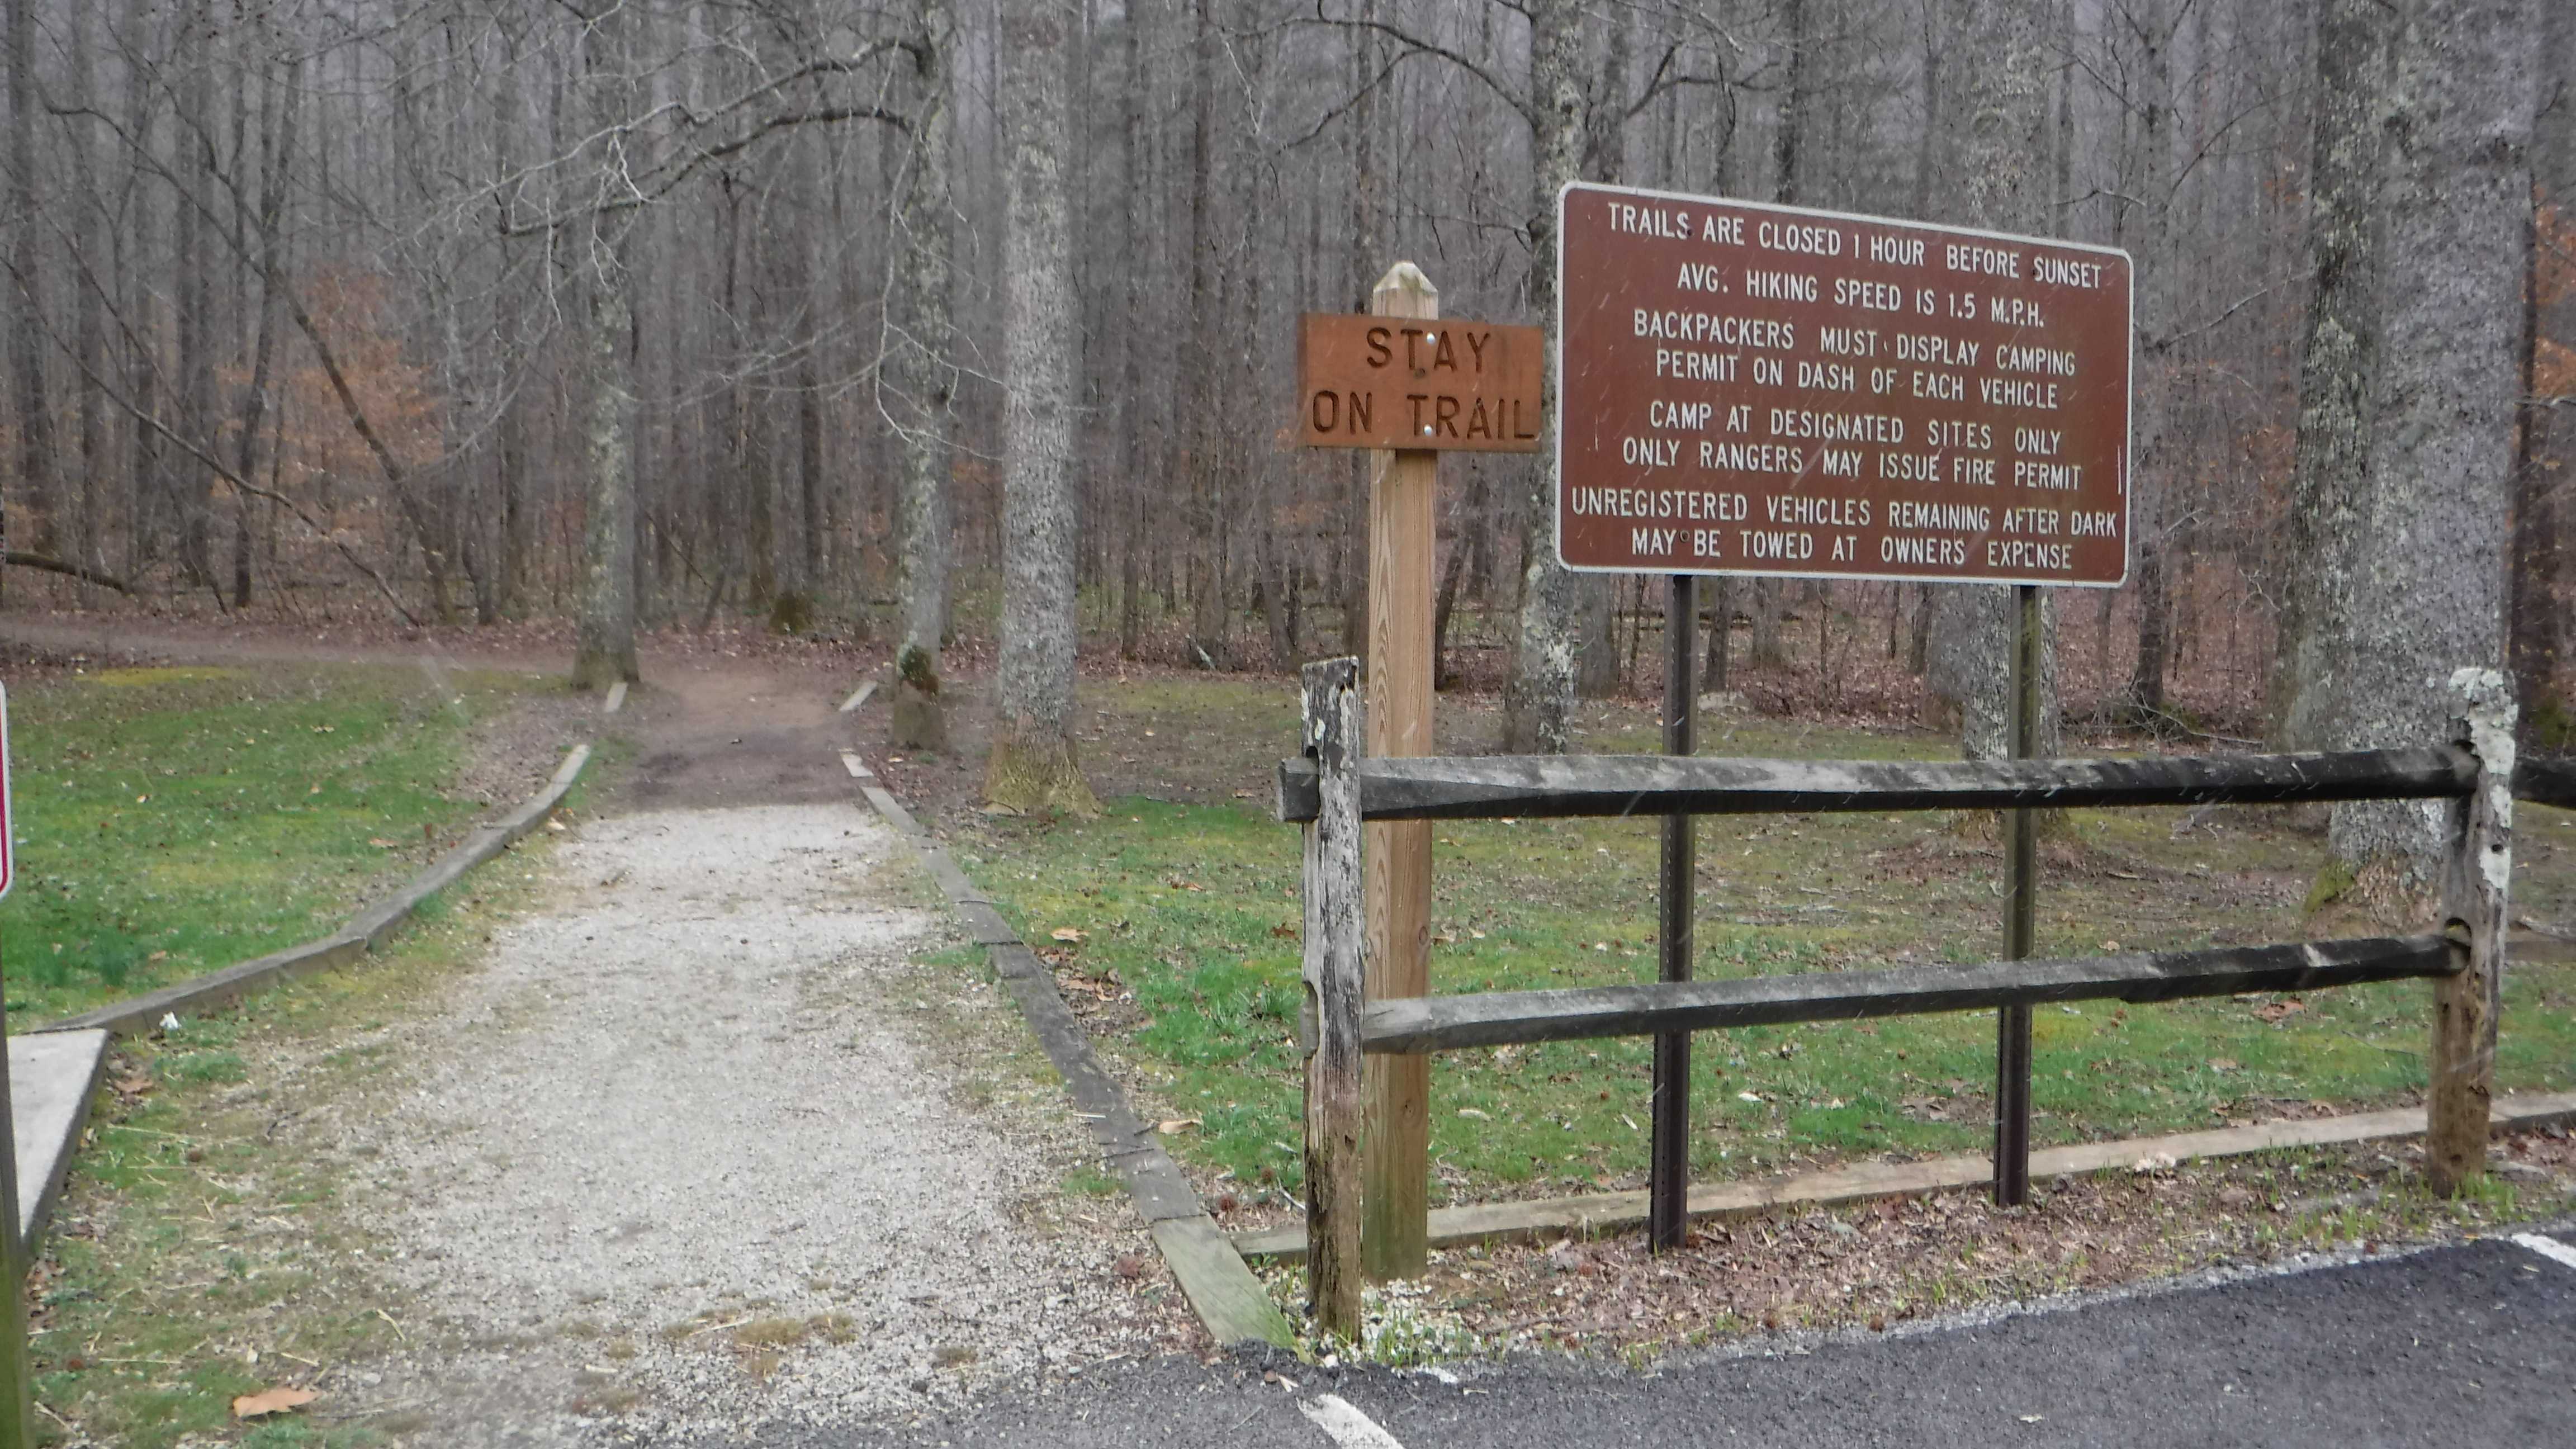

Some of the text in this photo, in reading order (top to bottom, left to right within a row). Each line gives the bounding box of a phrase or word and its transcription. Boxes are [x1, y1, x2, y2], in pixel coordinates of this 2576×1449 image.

[1608, 202, 2101, 288] TRAILS ARE CLOSED 1 HOUR BEFORE SUNSET
[1678, 262, 2044, 328] AVG. HIKING SPEED IS 1.5 M.P.H.
[1366, 327, 1490, 372] STAY
[1633, 308, 2076, 376] BACKPACKERS MUST DISPLAY CAMPING
[1656, 349, 2058, 409] PERMIT ON DASH OF EACH VEHICLE
[1313, 390, 1535, 439] ON TRAIL
[1650, 401, 2061, 455] CAMP AT DESIGNATED SITES ONLY
[1623, 437, 2082, 490] ONLY RANGERS MAY ISSUE FIRE PERMIT
[1571, 486, 2117, 537] UNREGISTERED VEHICLES REMAINING AFTER DARK
[1632, 528, 2072, 570] MAY BE TOWED AT OWNERS EXPENSE
